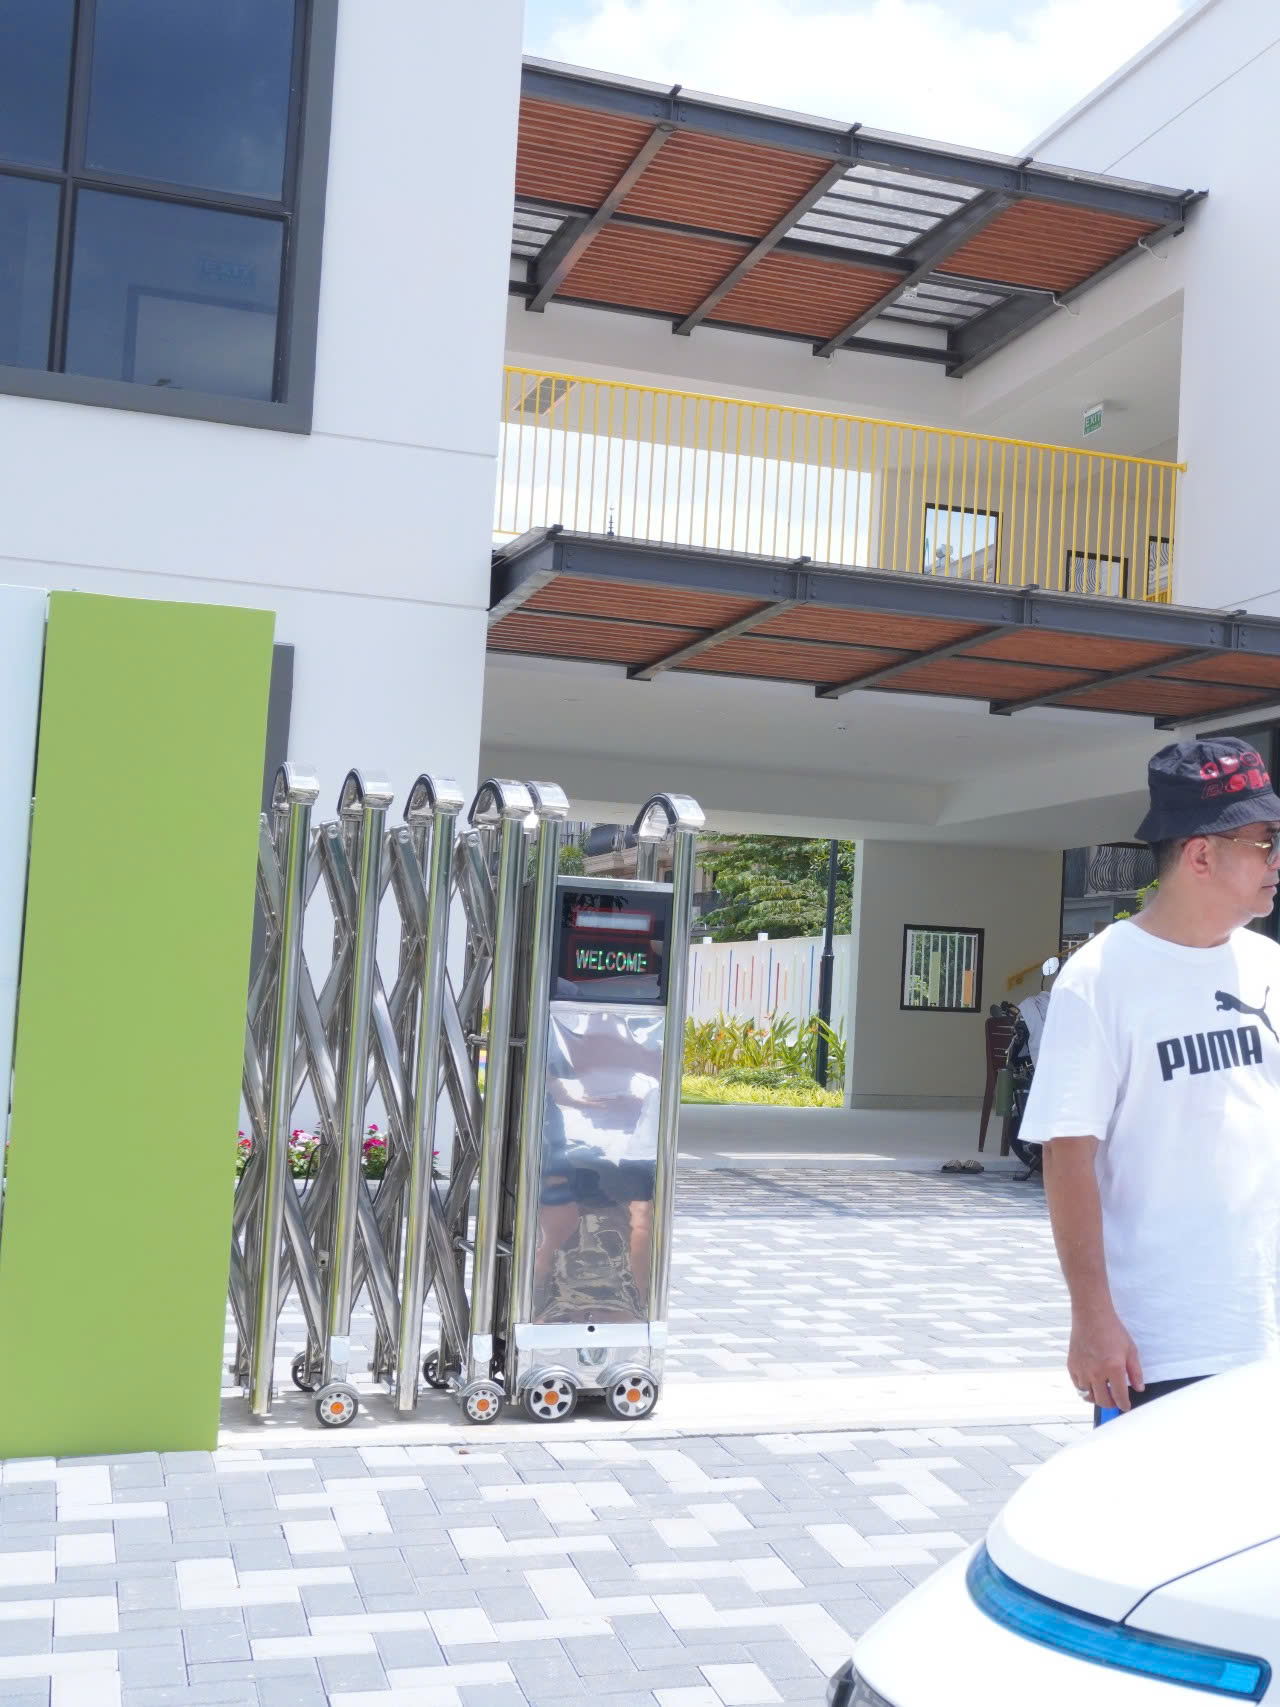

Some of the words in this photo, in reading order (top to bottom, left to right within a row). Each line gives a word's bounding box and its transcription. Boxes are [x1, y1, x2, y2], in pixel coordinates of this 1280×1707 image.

[1085, 411, 1101, 427] EXIT
[575, 949, 648, 973] WELCOME
[1156, 1025, 1262, 1082] PUMA
